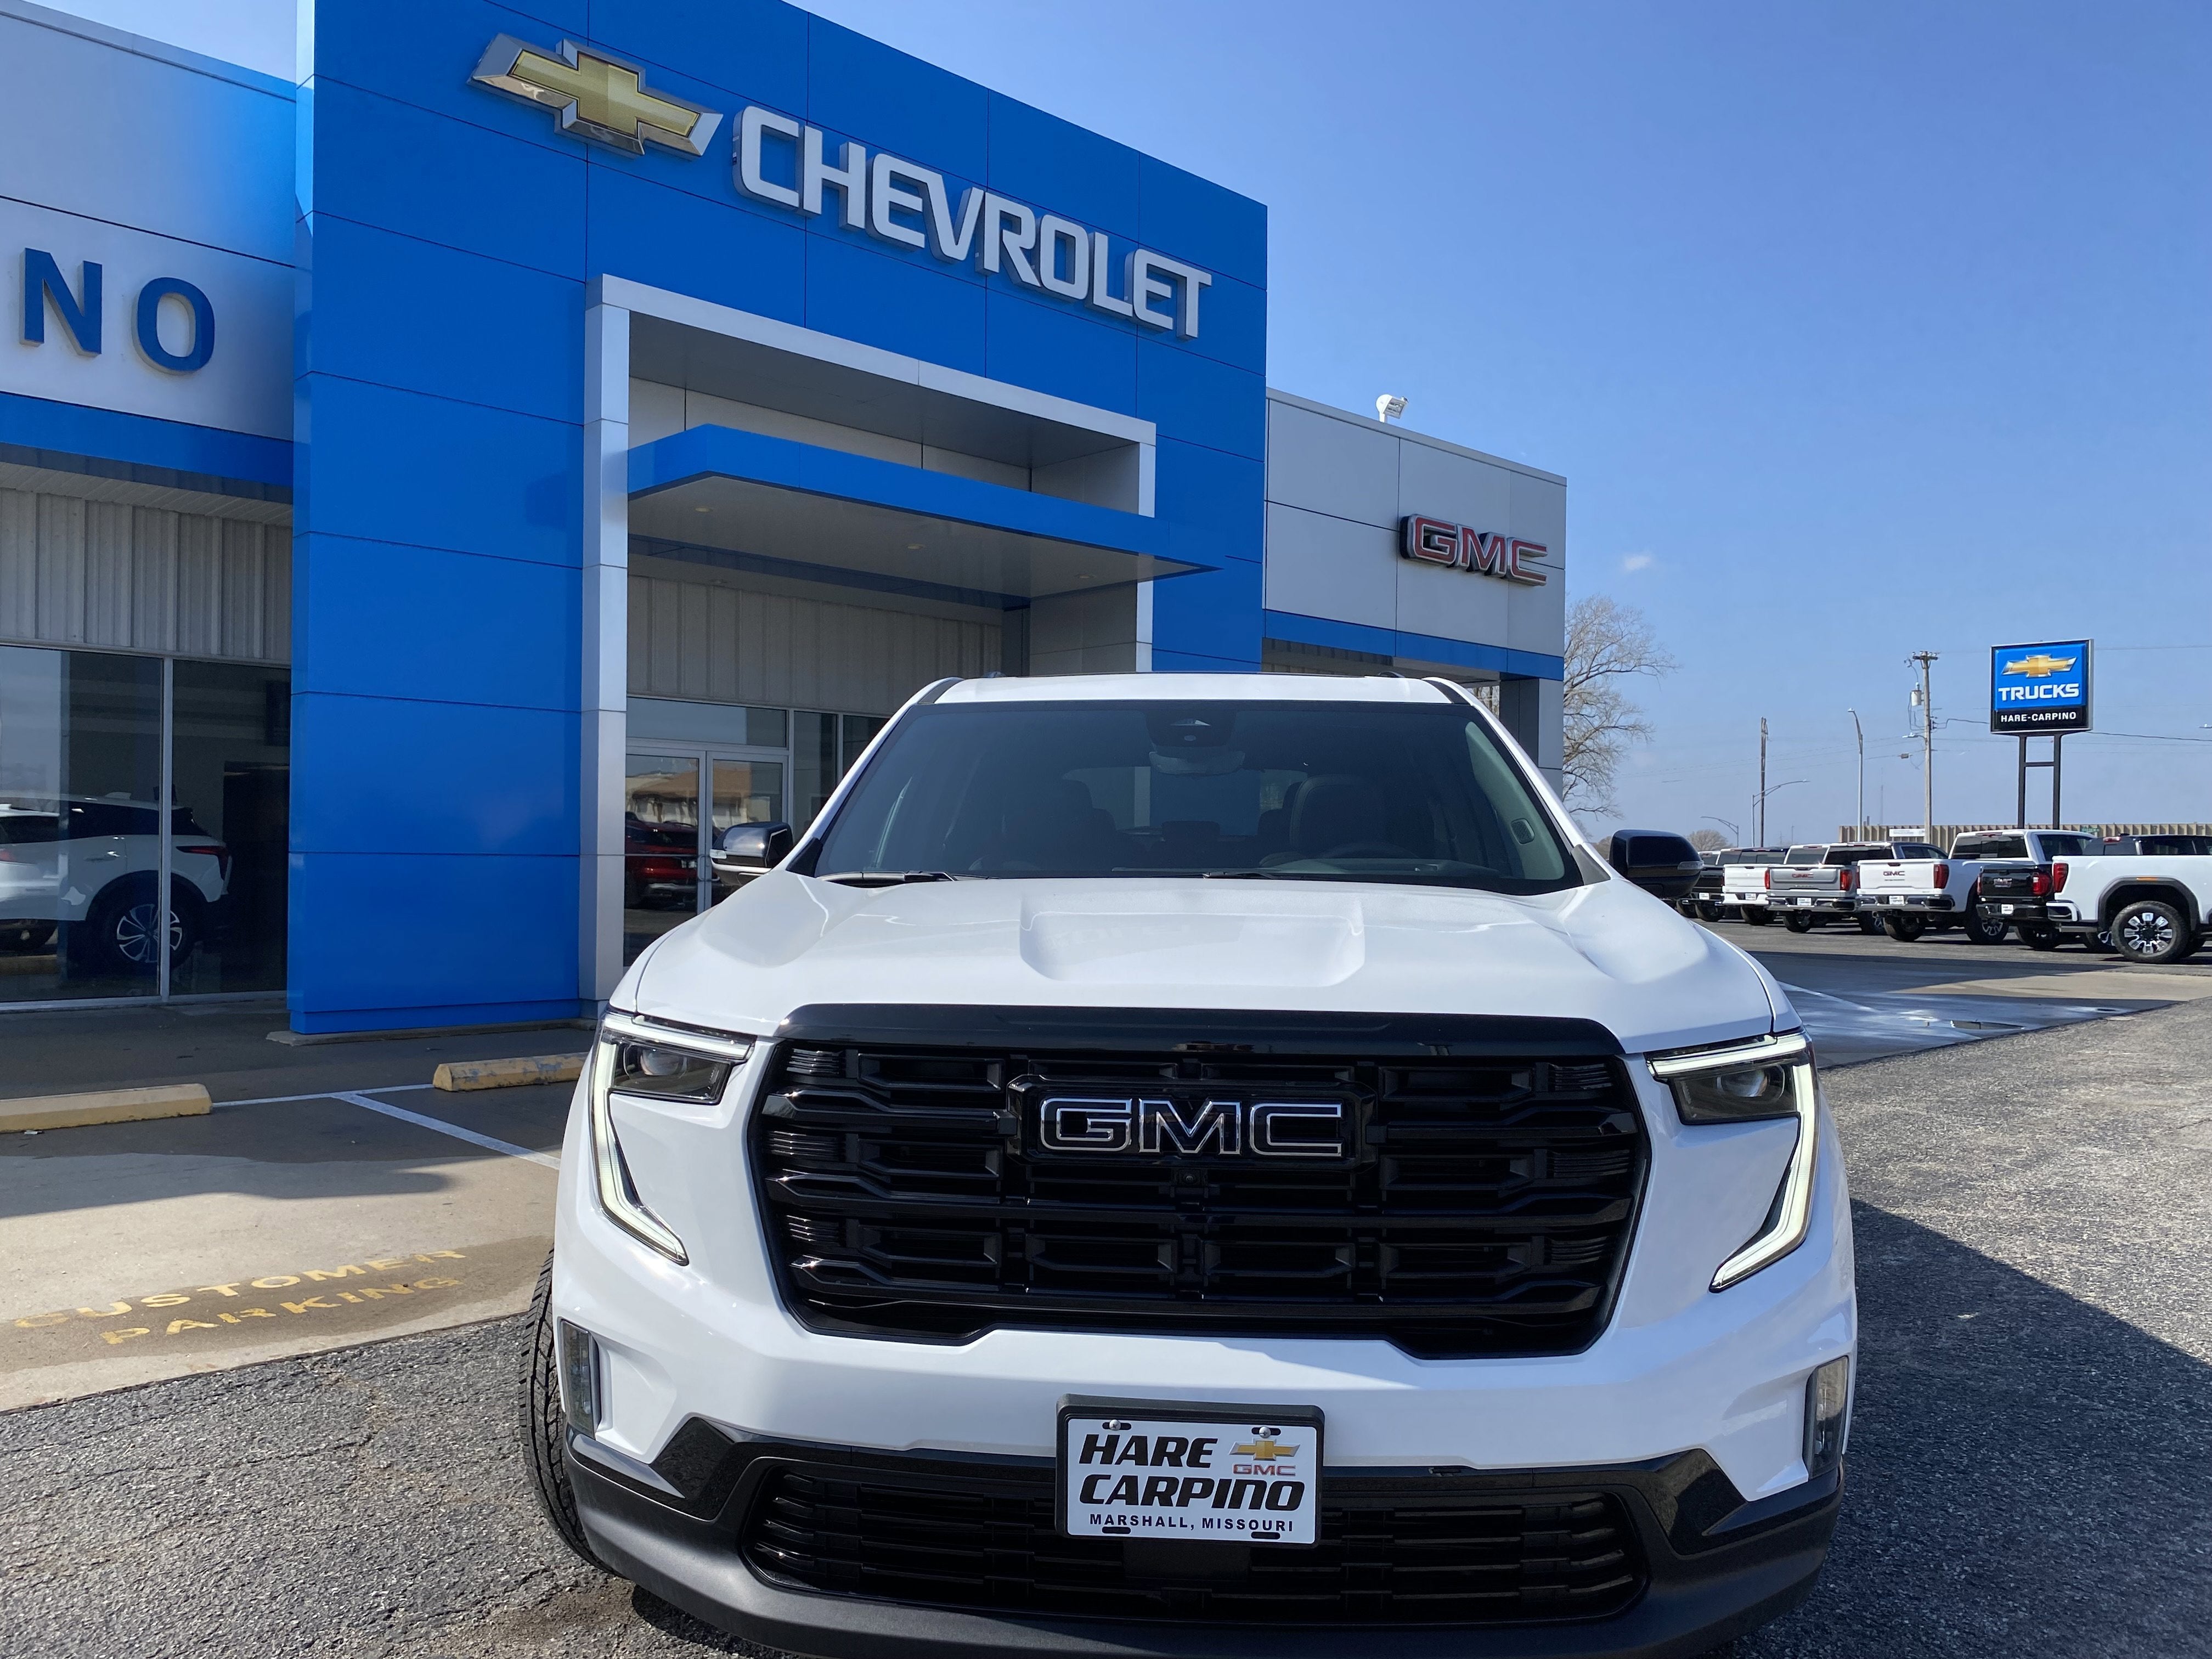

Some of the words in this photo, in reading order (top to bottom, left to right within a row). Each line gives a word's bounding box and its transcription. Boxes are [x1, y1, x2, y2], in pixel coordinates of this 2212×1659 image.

[733, 106, 1212, 340] CHEVROLET
[20, 248, 215, 375] NO
[1400, 514, 1548, 586] GMC
[1998, 683, 2079, 701] TRUCKS
[2001, 712, 2076, 723] HARE-CARPINO
[1041, 1098, 1343, 1156] GMC
[15, 1250, 466, 1328] CUSTOMER
[99, 1278, 464, 1345] PARKING
[1079, 1434, 1218, 1468] HARE
[1233, 1464, 1296, 1476] GMC
[1079, 1474, 1305, 1511] CARPINO
[1090, 1514, 1194, 1530] MARSHALL,
[1202, 1518, 1293, 1532] MISSOURI
